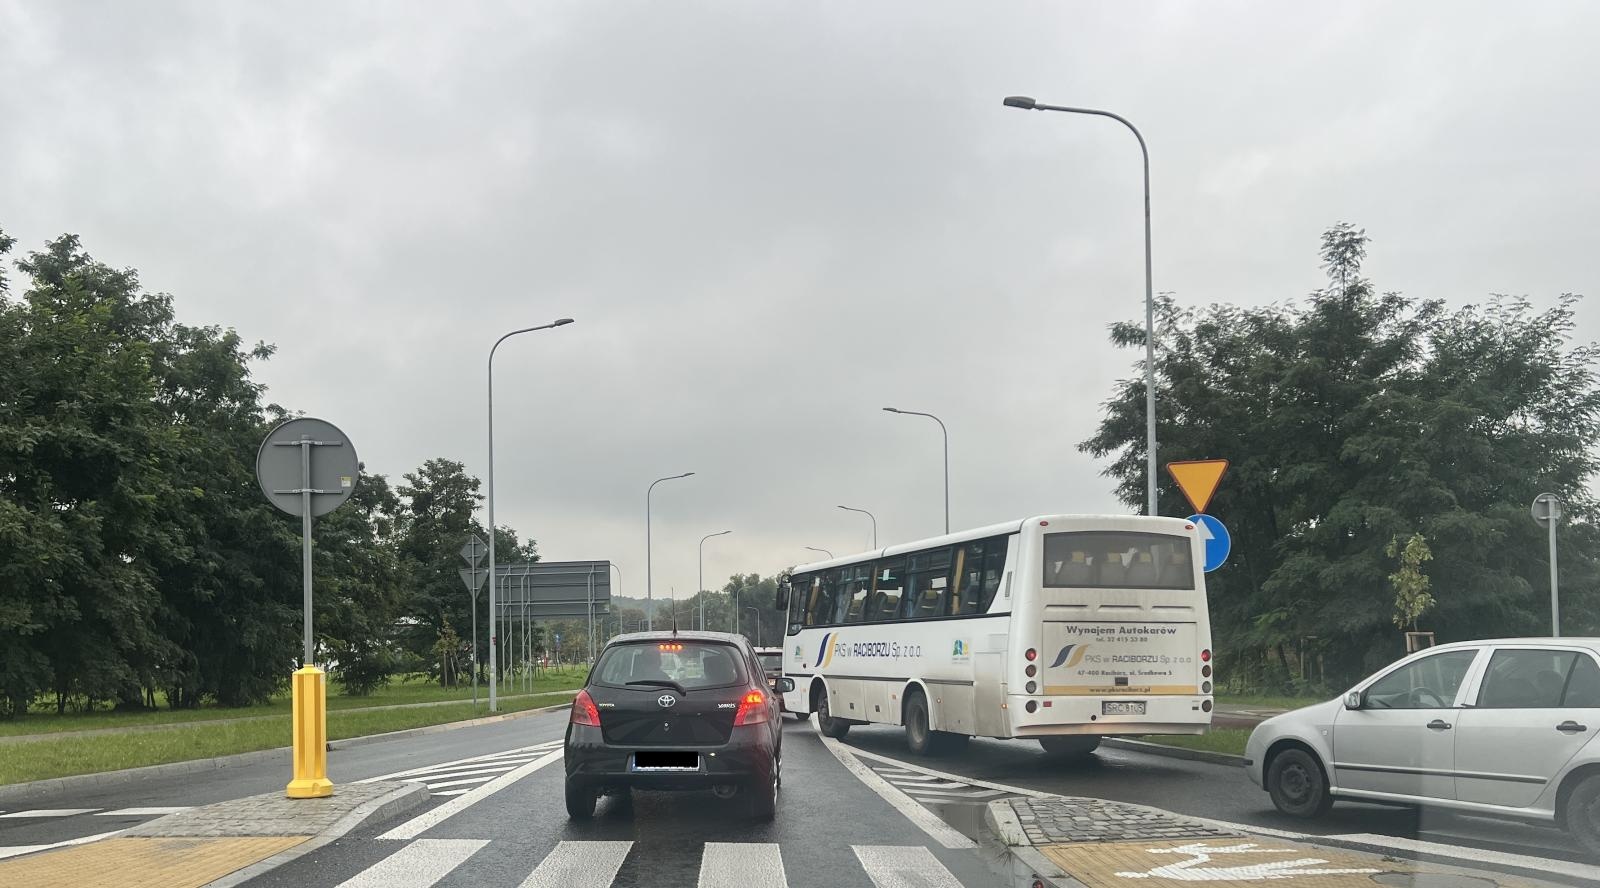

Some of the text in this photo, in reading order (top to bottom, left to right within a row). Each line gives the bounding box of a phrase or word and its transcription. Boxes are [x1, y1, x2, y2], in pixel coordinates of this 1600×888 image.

[1066, 625, 1177, 636] Wynajem Autokarów
[834, 642, 847, 657] PKS
[853, 642, 890, 657] RACIBORZU
[903, 645, 908, 657] z
[1085, 655, 1102, 663] PKS
[1112, 655, 1158, 663] RACIBORZU
[1106, 703, 1124, 713] SRC
